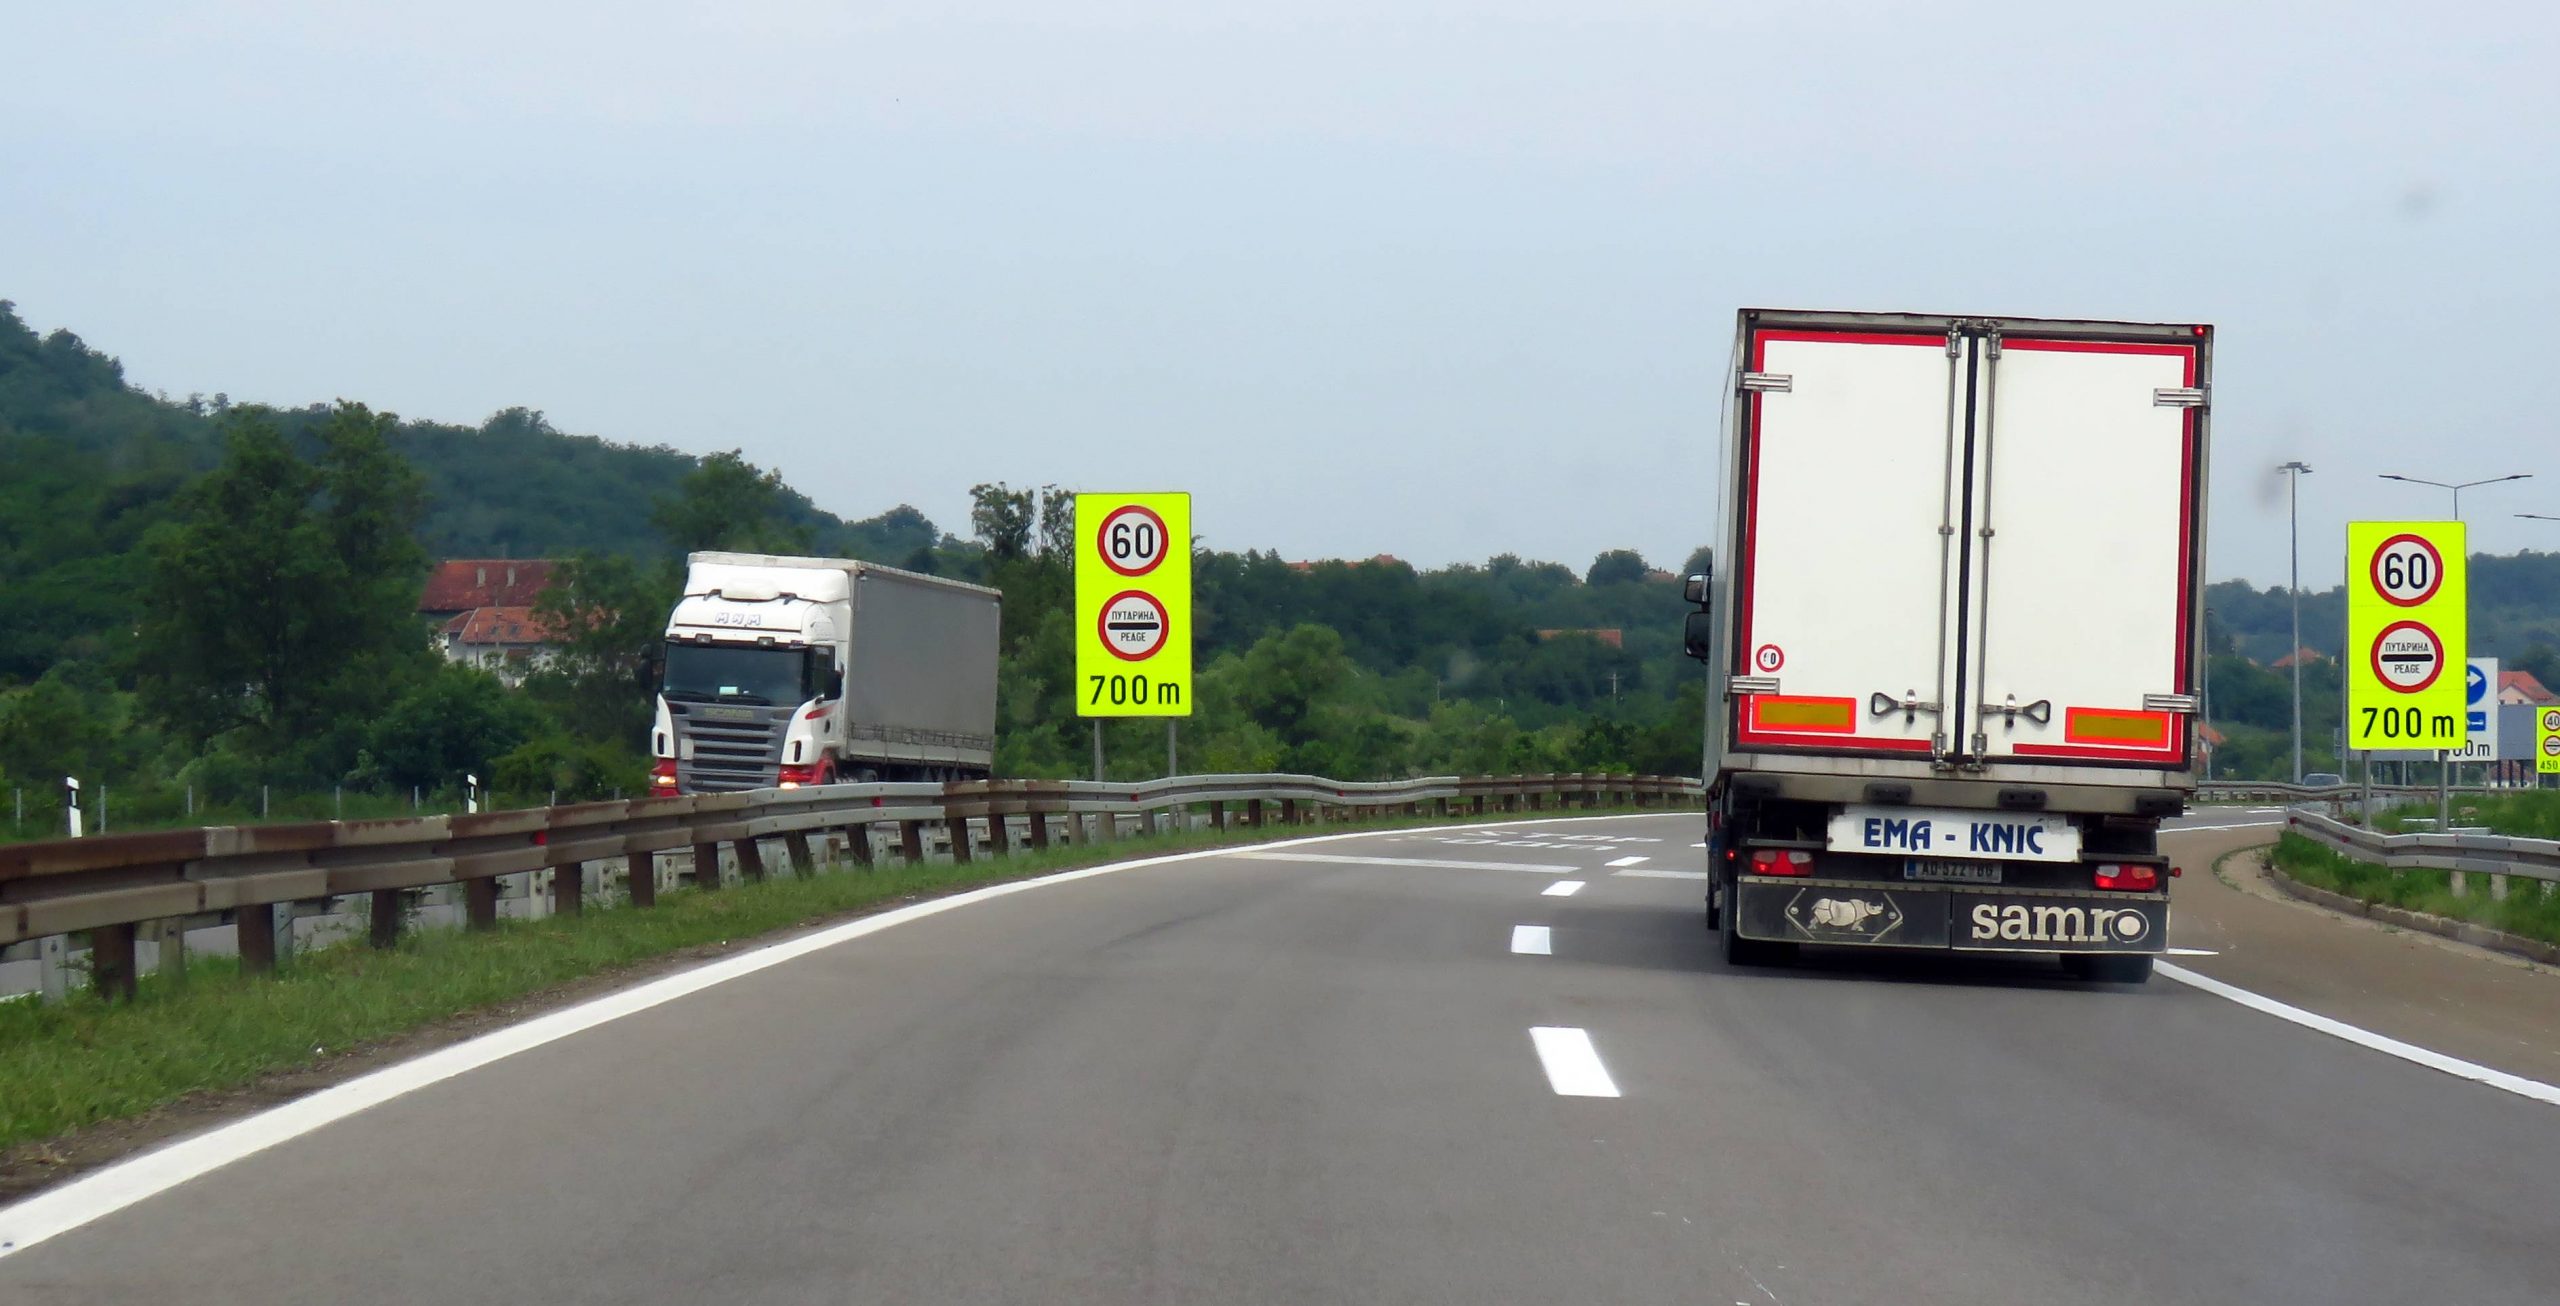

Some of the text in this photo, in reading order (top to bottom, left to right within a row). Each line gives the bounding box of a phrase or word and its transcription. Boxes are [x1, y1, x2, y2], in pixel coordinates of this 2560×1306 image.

[1111, 522, 1154, 559] 60
[2384, 552, 2428, 590] 60
[1111, 610, 1155, 621] ПУТАРИНА
[1120, 631, 1146, 642] PEAGE
[2384, 641, 2430, 652] ПУТАРИНА
[2393, 663, 2421, 674] PEAGE
[1089, 674, 1180, 705] 700 m
[2361, 706, 2455, 738] 700 m
[2547, 715, 2560, 727] 40
[2477, 743, 2490, 757] m
[2540, 760, 2558, 771] 450
[1863, 817, 1932, 852] EMA
[1971, 903, 2150, 944] samro
